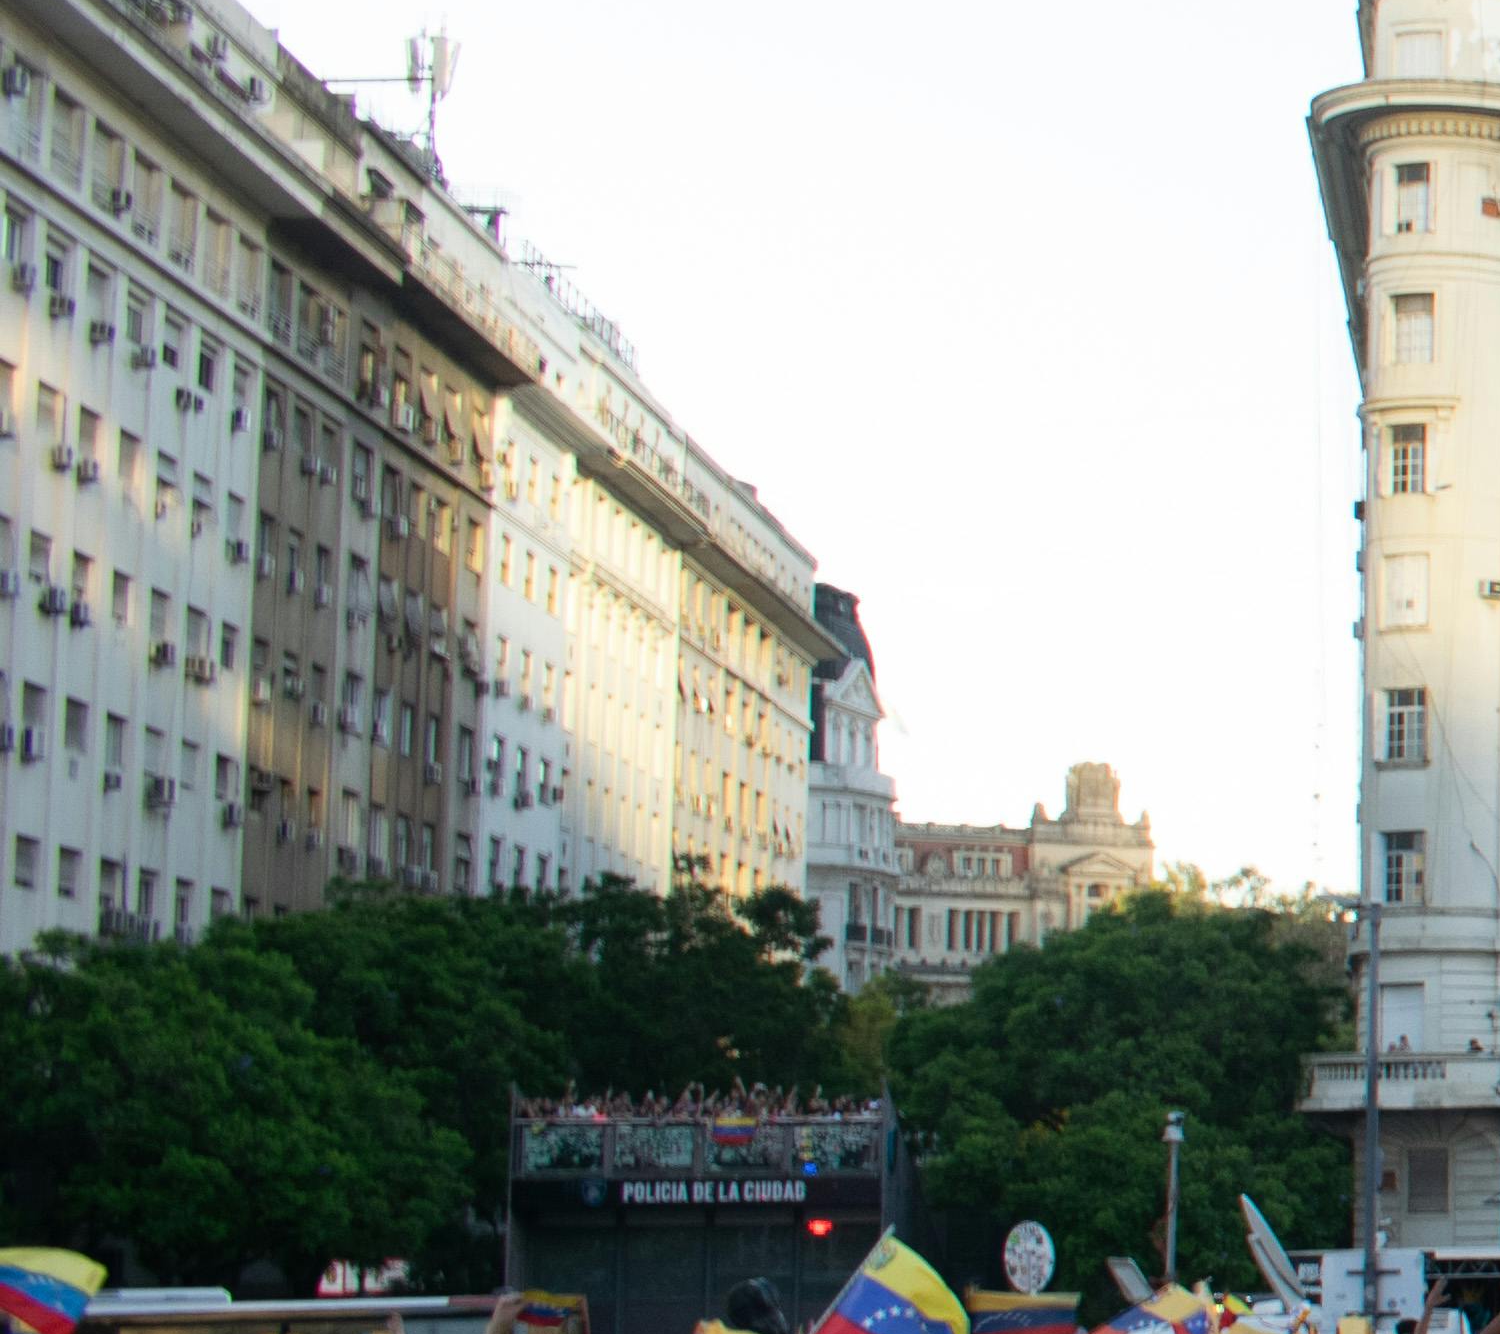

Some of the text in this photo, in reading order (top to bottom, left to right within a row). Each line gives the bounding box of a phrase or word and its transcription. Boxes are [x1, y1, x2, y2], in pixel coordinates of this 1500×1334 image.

[693, 1180, 715, 1203] DE
[718, 1180, 740, 1203] LA
[744, 1180, 807, 1203] CIUDAD
